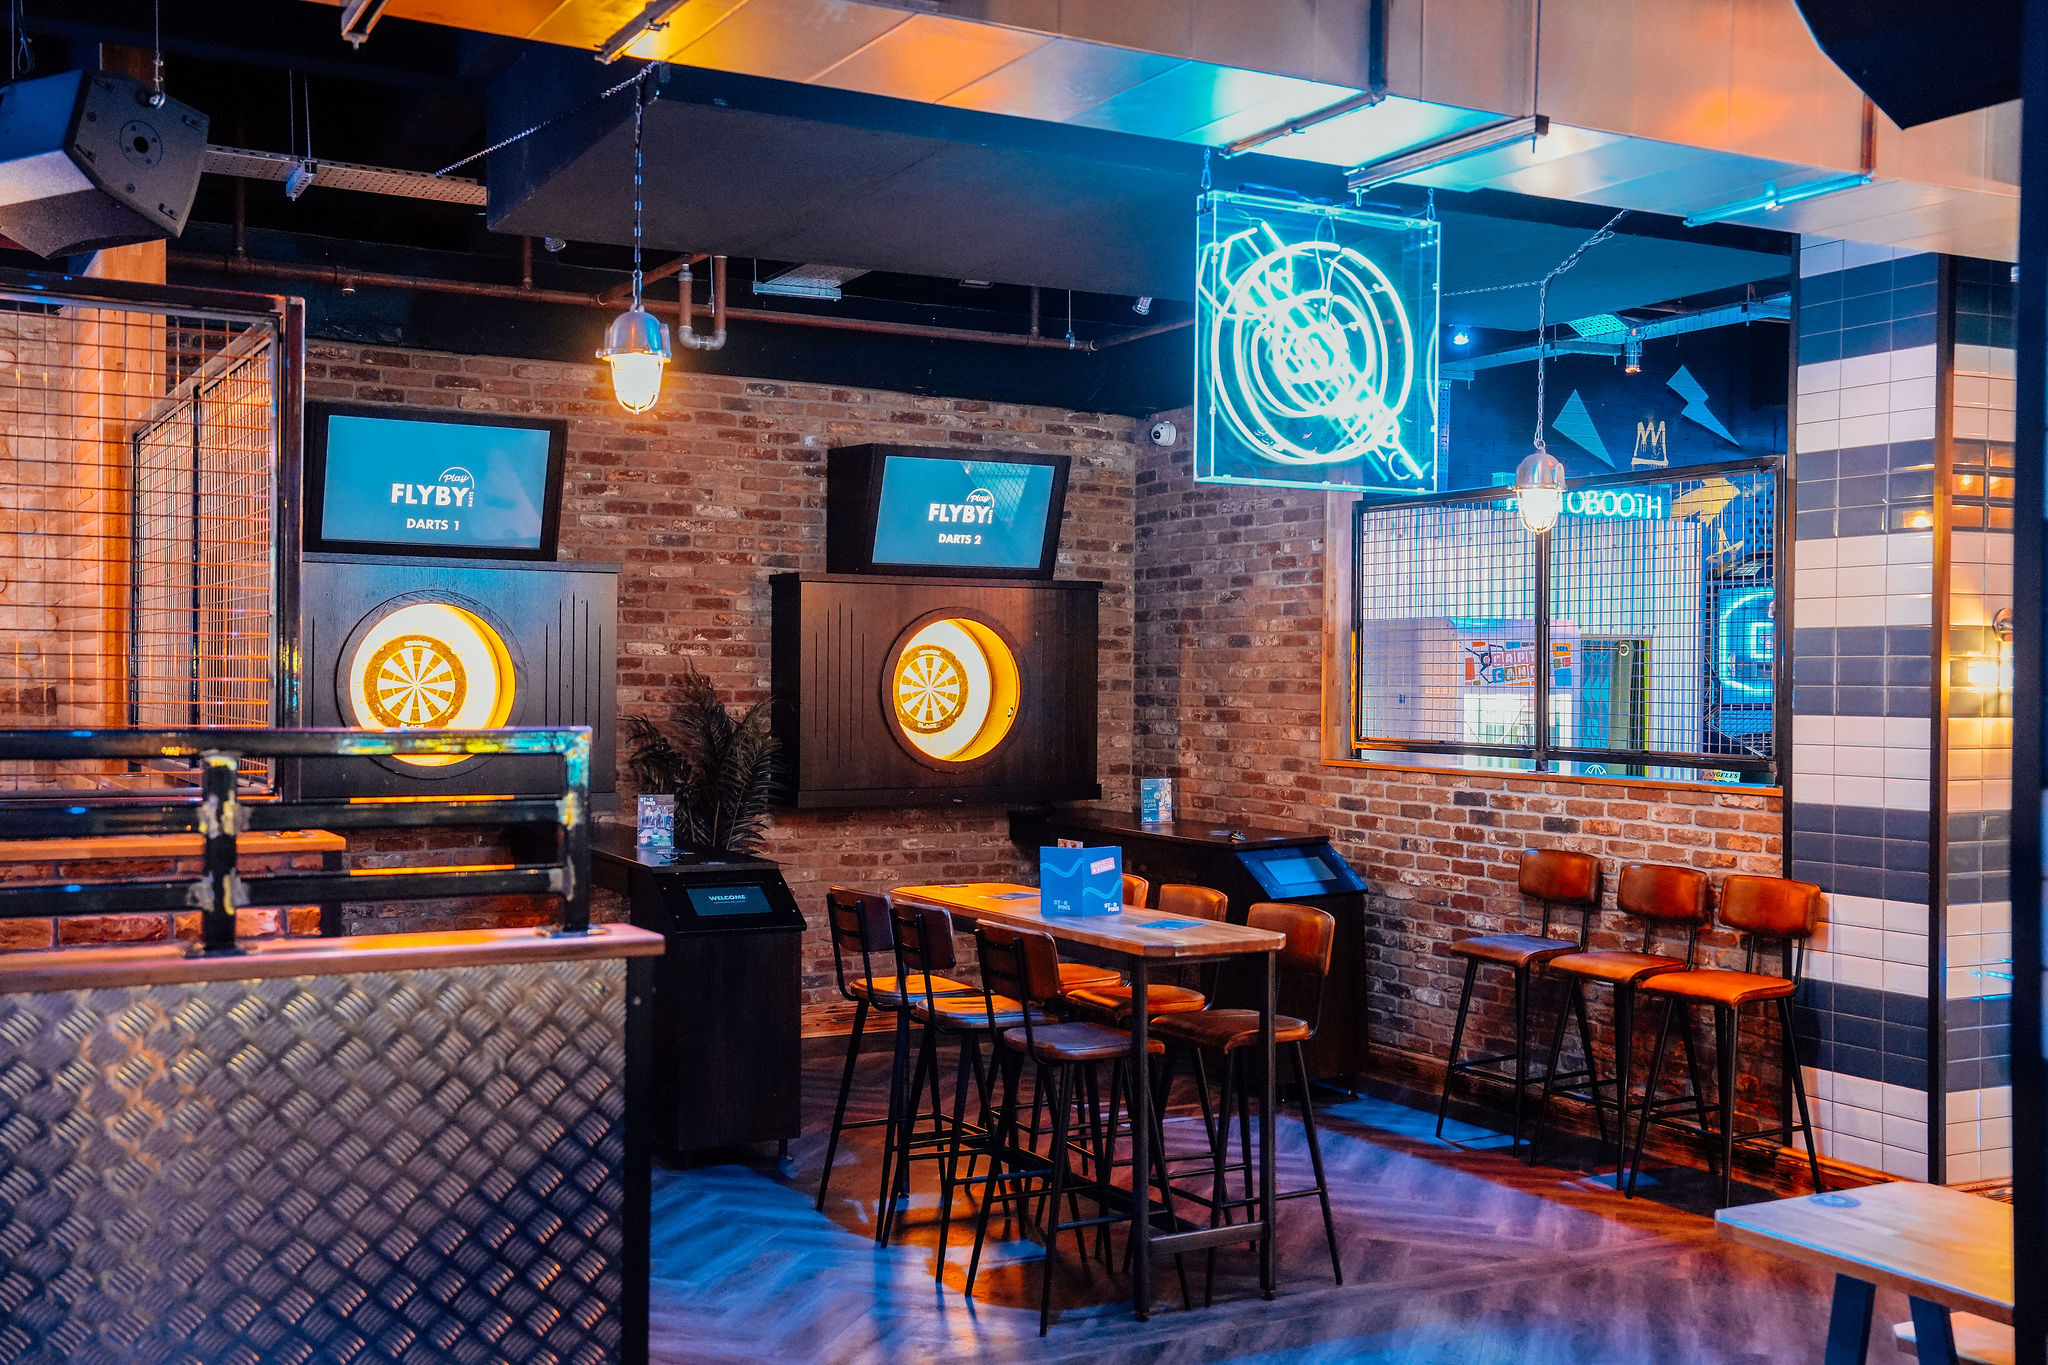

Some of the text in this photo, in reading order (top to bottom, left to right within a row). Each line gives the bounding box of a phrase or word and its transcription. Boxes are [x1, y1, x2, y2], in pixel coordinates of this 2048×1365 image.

[443, 473, 470, 483] Play
[391, 483, 470, 507] FLYBY
[970, 494, 991, 503] Play
[928, 503, 990, 524] FLYBY
[406, 518, 460, 531] DARTS 1
[938, 533, 982, 545] DARTS 2
